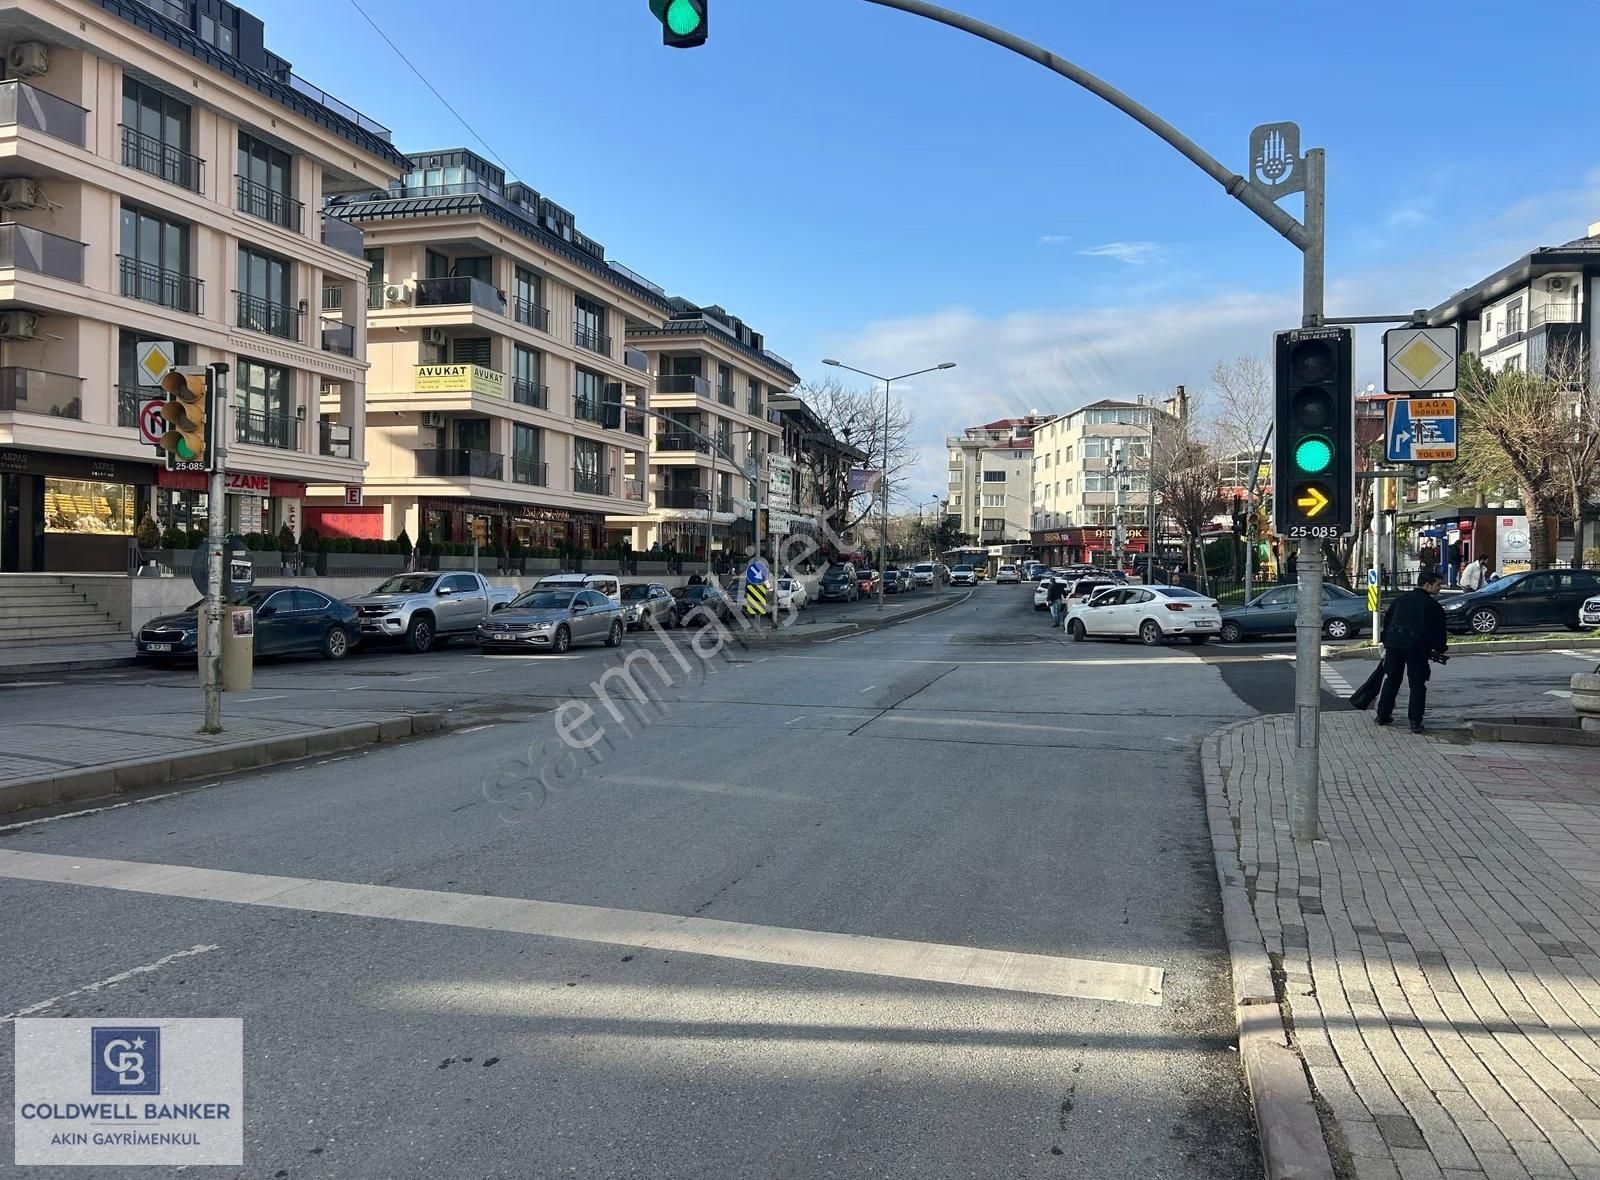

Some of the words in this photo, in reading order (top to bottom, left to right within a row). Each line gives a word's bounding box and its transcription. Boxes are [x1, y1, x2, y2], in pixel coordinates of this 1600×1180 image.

[418, 366, 467, 376] AVUKAT
[474, 367, 504, 383] AVUKAT
[1417, 400, 1447, 408] SAĞA
[224, 472, 269, 490] CZANE
[1290, 526, 1338, 537] 25-085
